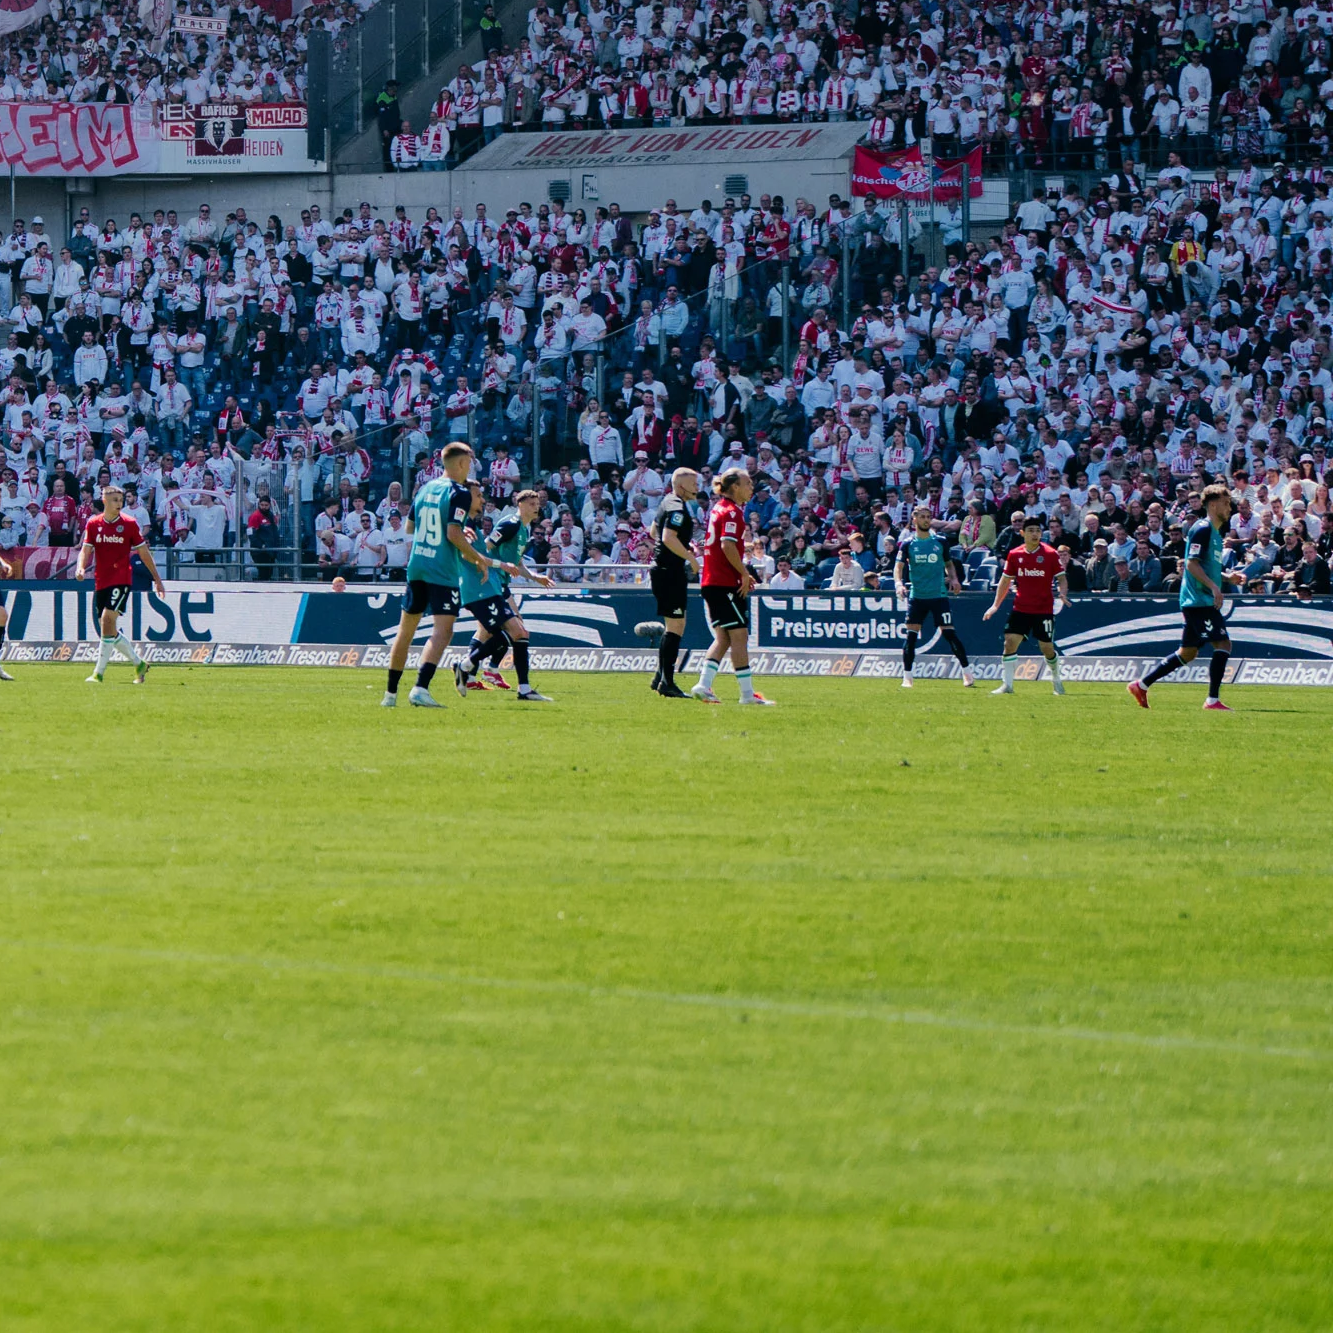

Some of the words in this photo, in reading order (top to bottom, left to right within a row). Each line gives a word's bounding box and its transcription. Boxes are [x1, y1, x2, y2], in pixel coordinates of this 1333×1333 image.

[179, 19, 222, 30] MALAD
[201, 104, 239, 117] RAFIKIS
[252, 108, 303, 127] MALAD
[244, 138, 284, 157] HEIDEN
[528, 134, 627, 157] HEINZ
[629, 131, 693, 154] VON
[696, 128, 823, 151] HEIDEN
[186, 157, 241, 165] MASSIVHÄUSER
[417, 506, 443, 547] 19
[102, 533, 124, 544] heise
[1024, 567, 1045, 577] heise
[111, 587, 121, 600] 9
[53, 590, 215, 643] ise
[941, 611, 952, 624] 17
[1042, 619, 1053, 633] 11
[7, 643, 72, 661] Tresore.de
[215, 645, 287, 664] Eisenbach
[288, 647, 359, 666] Tresore.de
[528, 648, 602, 669] isenbach
[603, 649, 671, 670] Tresore
[766, 652, 855, 676] Tresore.de
[857, 656, 947, 678] Eisenach
[1236, 659, 1333, 684] Eisenbach
